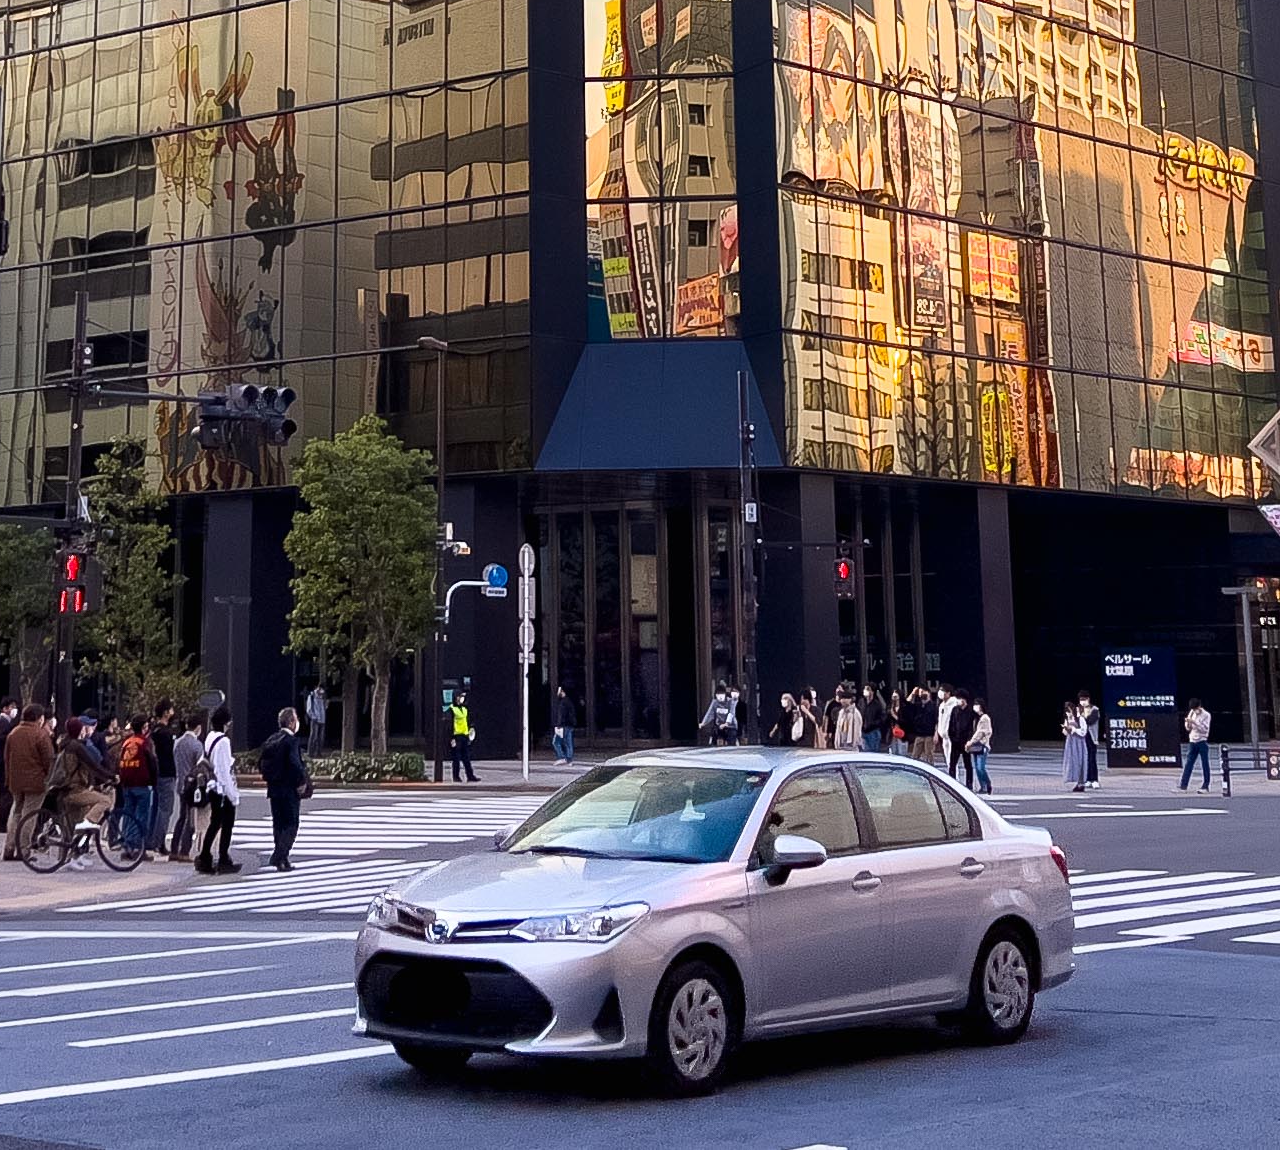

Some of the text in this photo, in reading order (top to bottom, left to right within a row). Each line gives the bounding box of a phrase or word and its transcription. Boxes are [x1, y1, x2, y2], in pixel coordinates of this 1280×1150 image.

[1104, 654, 1152, 665] ベルサール
